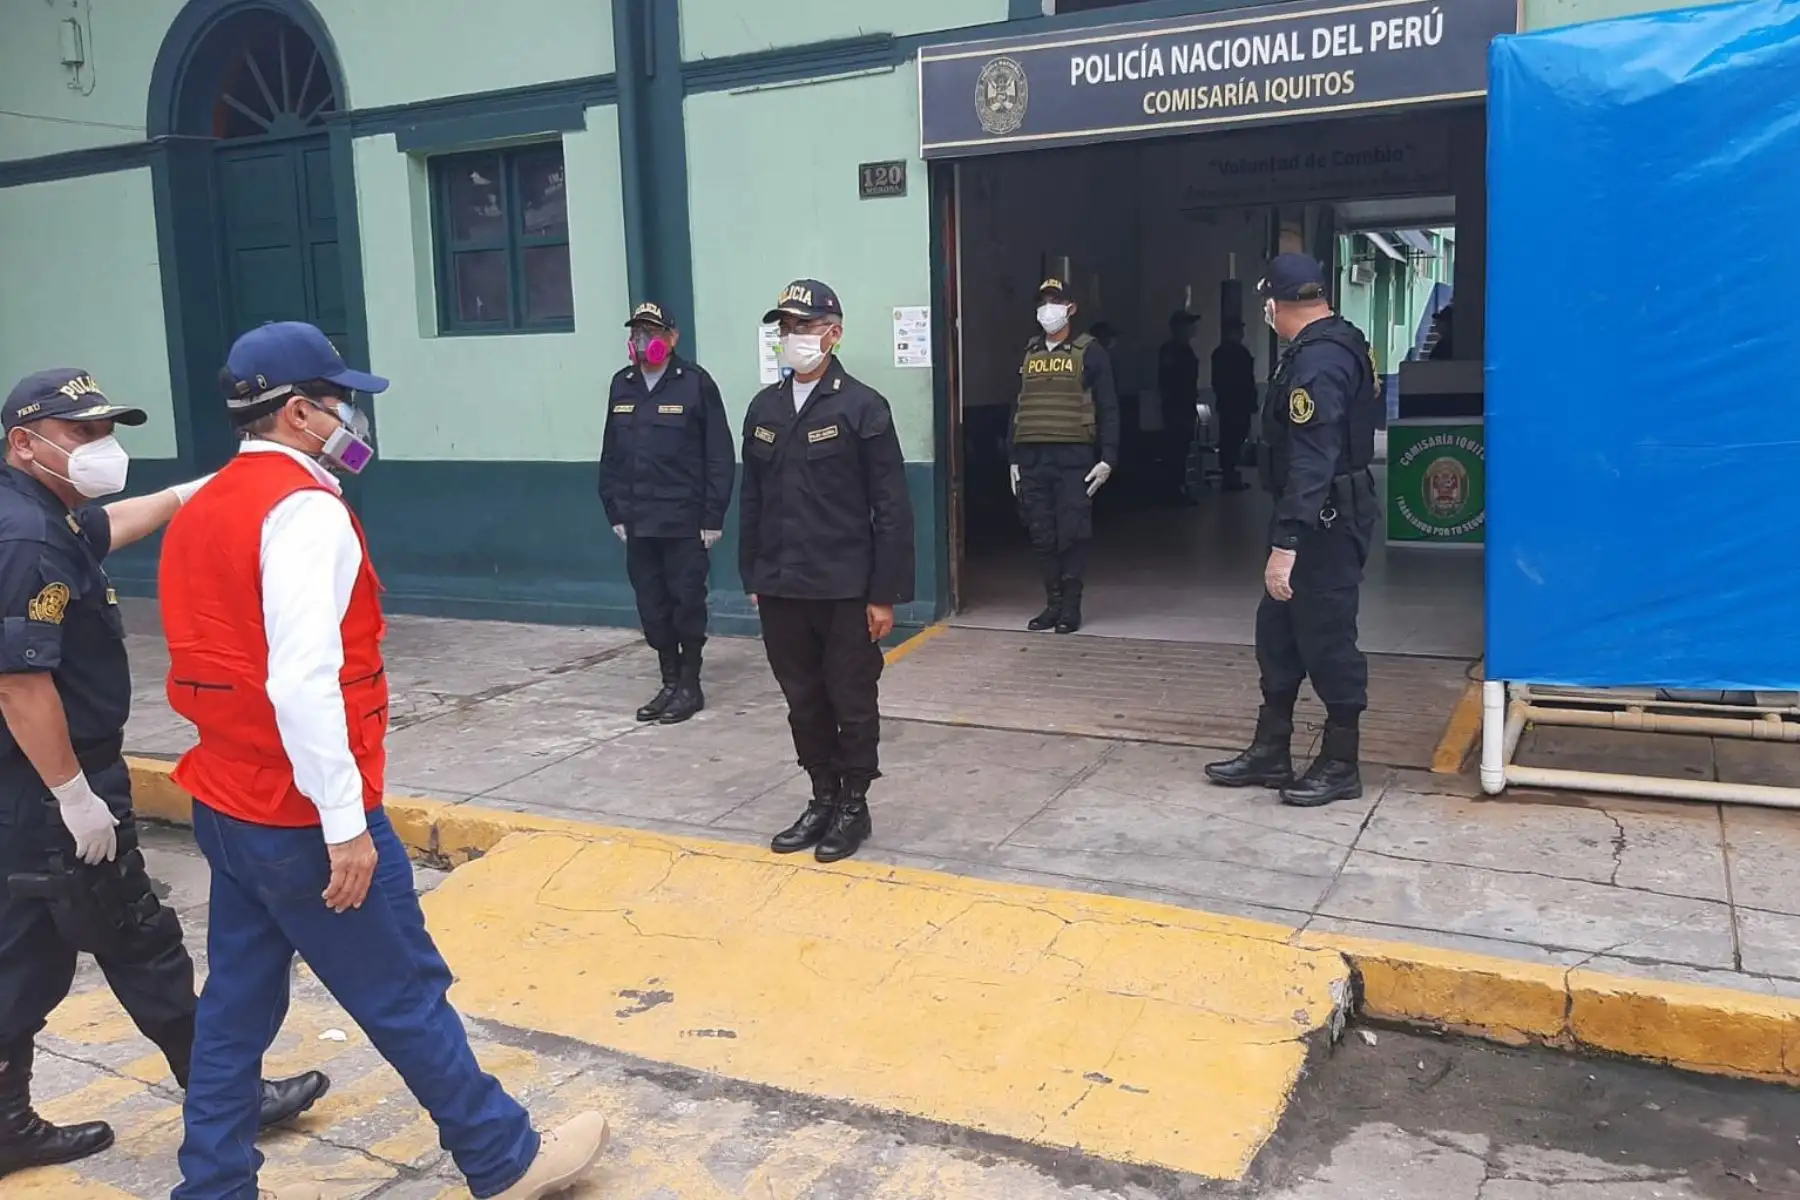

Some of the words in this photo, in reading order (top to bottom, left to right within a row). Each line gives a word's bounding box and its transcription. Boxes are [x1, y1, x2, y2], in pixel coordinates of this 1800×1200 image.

[1070, 43, 1164, 86] POLICÍA
[1171, 31, 1305, 75] NACIONAL
[1312, 24, 1363, 57] DEL
[1370, 7, 1444, 53] PERÚ
[1142, 76, 1259, 116] COMISARÍA
[1265, 69, 1355, 105] IQUITOS
[863, 166, 901, 188] 120
[1028, 358, 1073, 374] POLICIA
